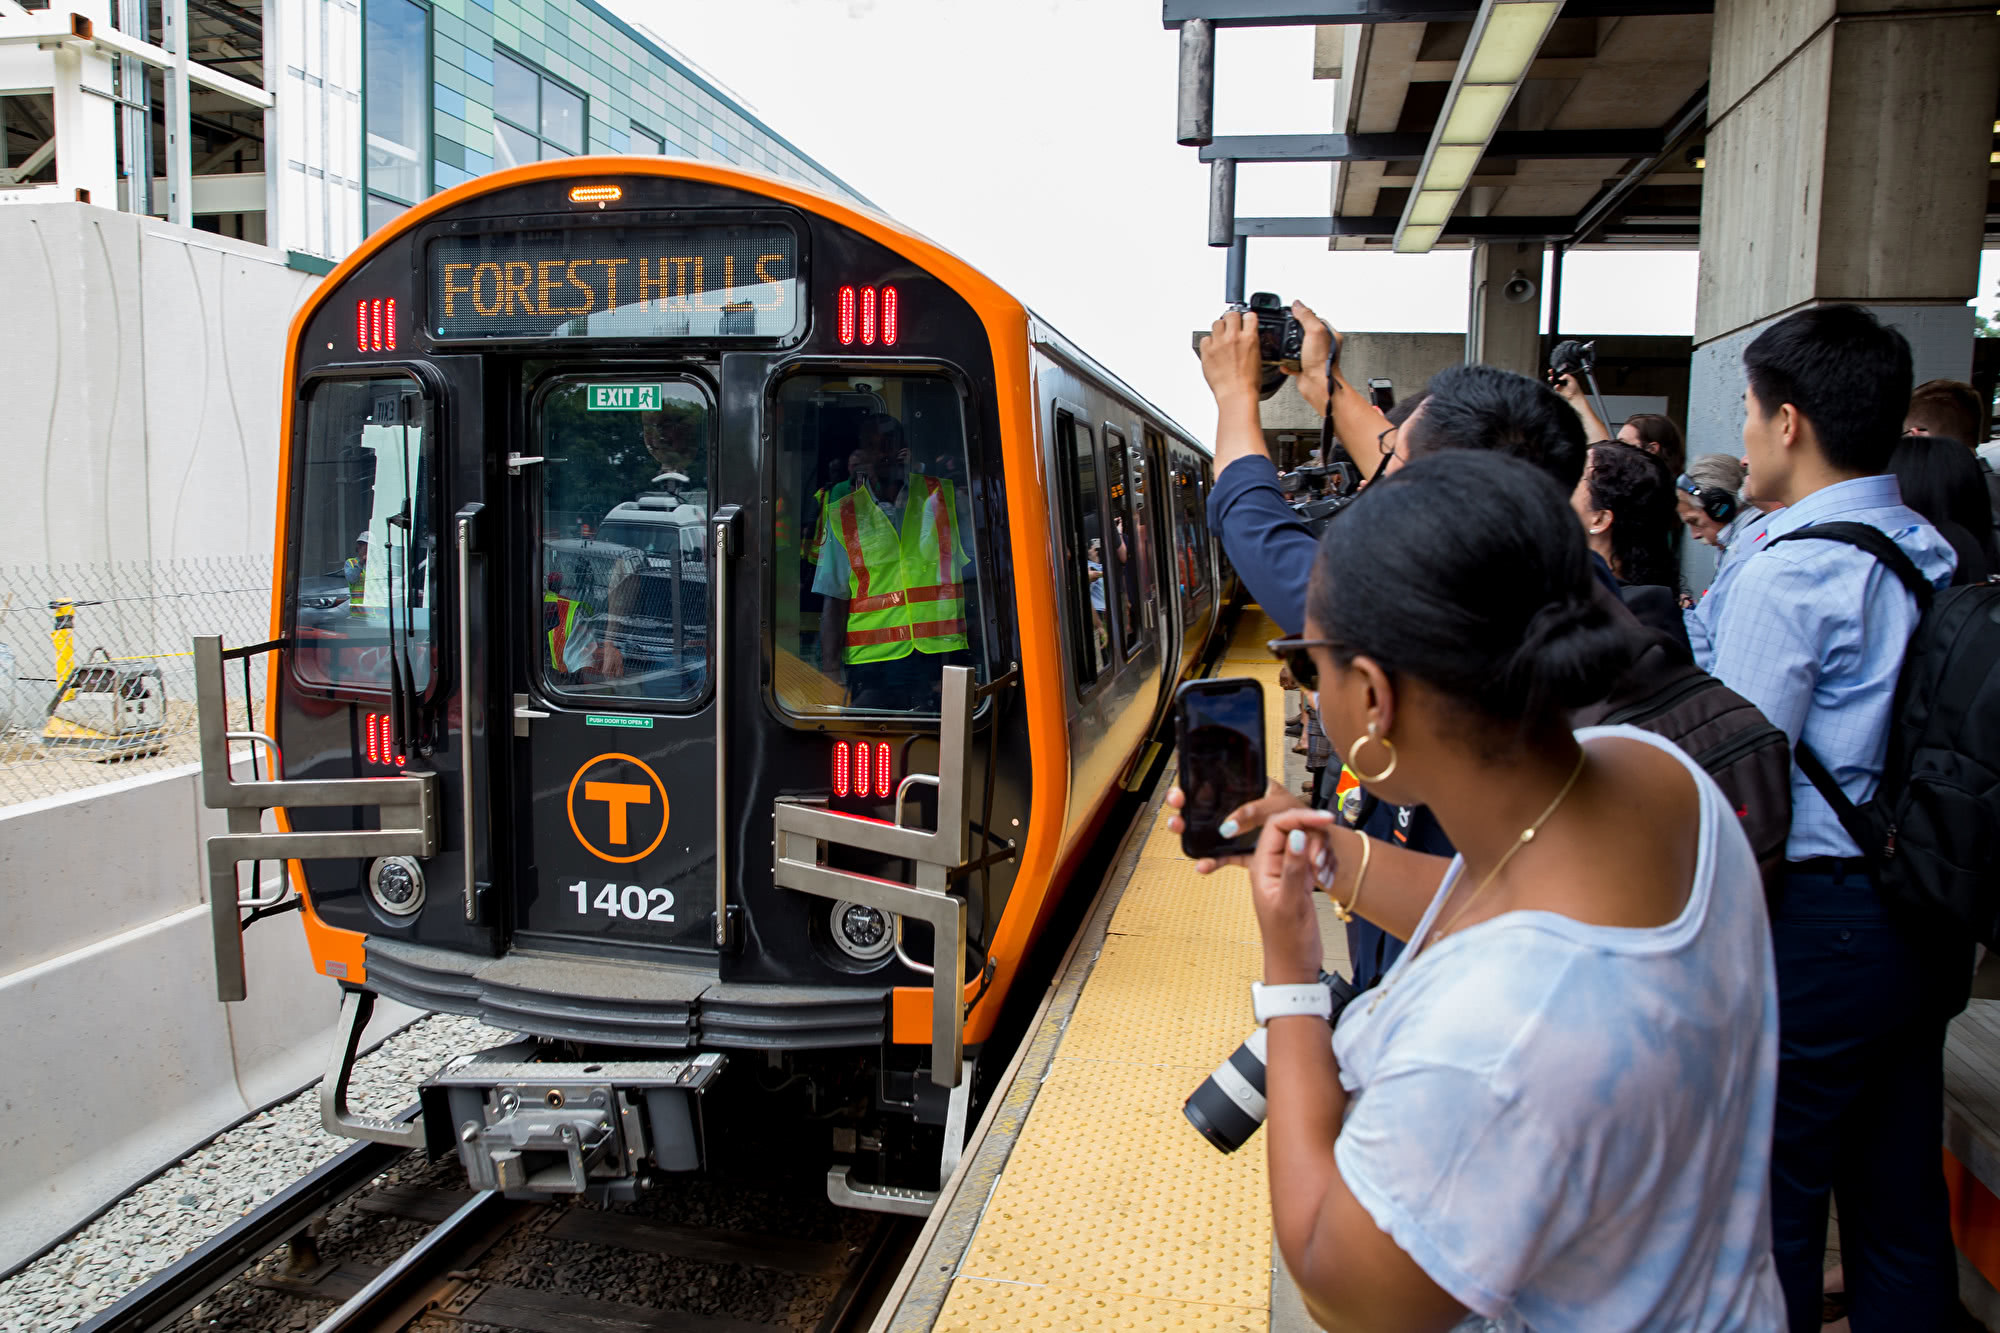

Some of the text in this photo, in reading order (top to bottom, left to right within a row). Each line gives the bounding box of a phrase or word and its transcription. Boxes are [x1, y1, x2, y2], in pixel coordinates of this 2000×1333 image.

[443, 253, 784, 317] FOREST HILLS
[597, 387, 634, 406] EXIT
[585, 781, 650, 845] T
[569, 880, 675, 923] 1402
